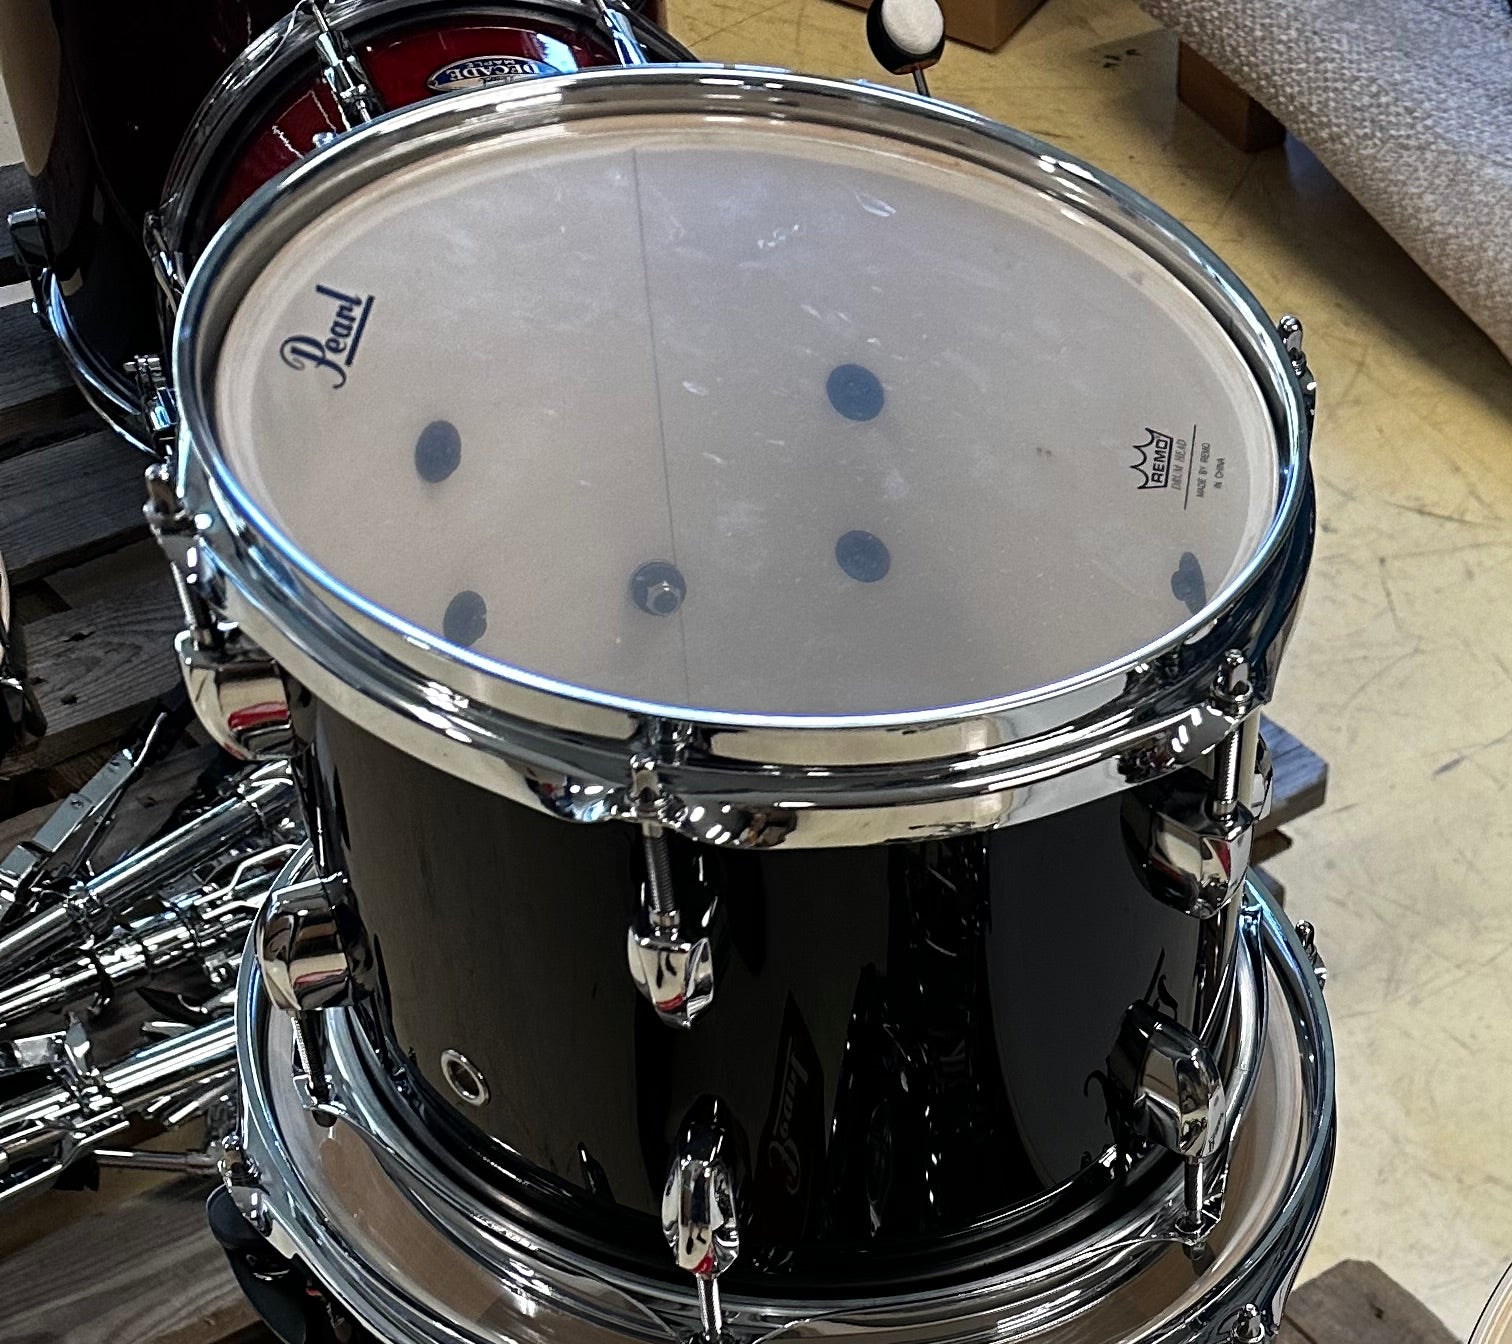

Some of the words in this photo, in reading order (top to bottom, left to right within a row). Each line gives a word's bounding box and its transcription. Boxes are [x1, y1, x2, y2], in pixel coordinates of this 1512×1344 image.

[446, 62, 540, 80] DECADE
[280, 284, 375, 389] Pearl
[1151, 438, 1168, 483] REMO
